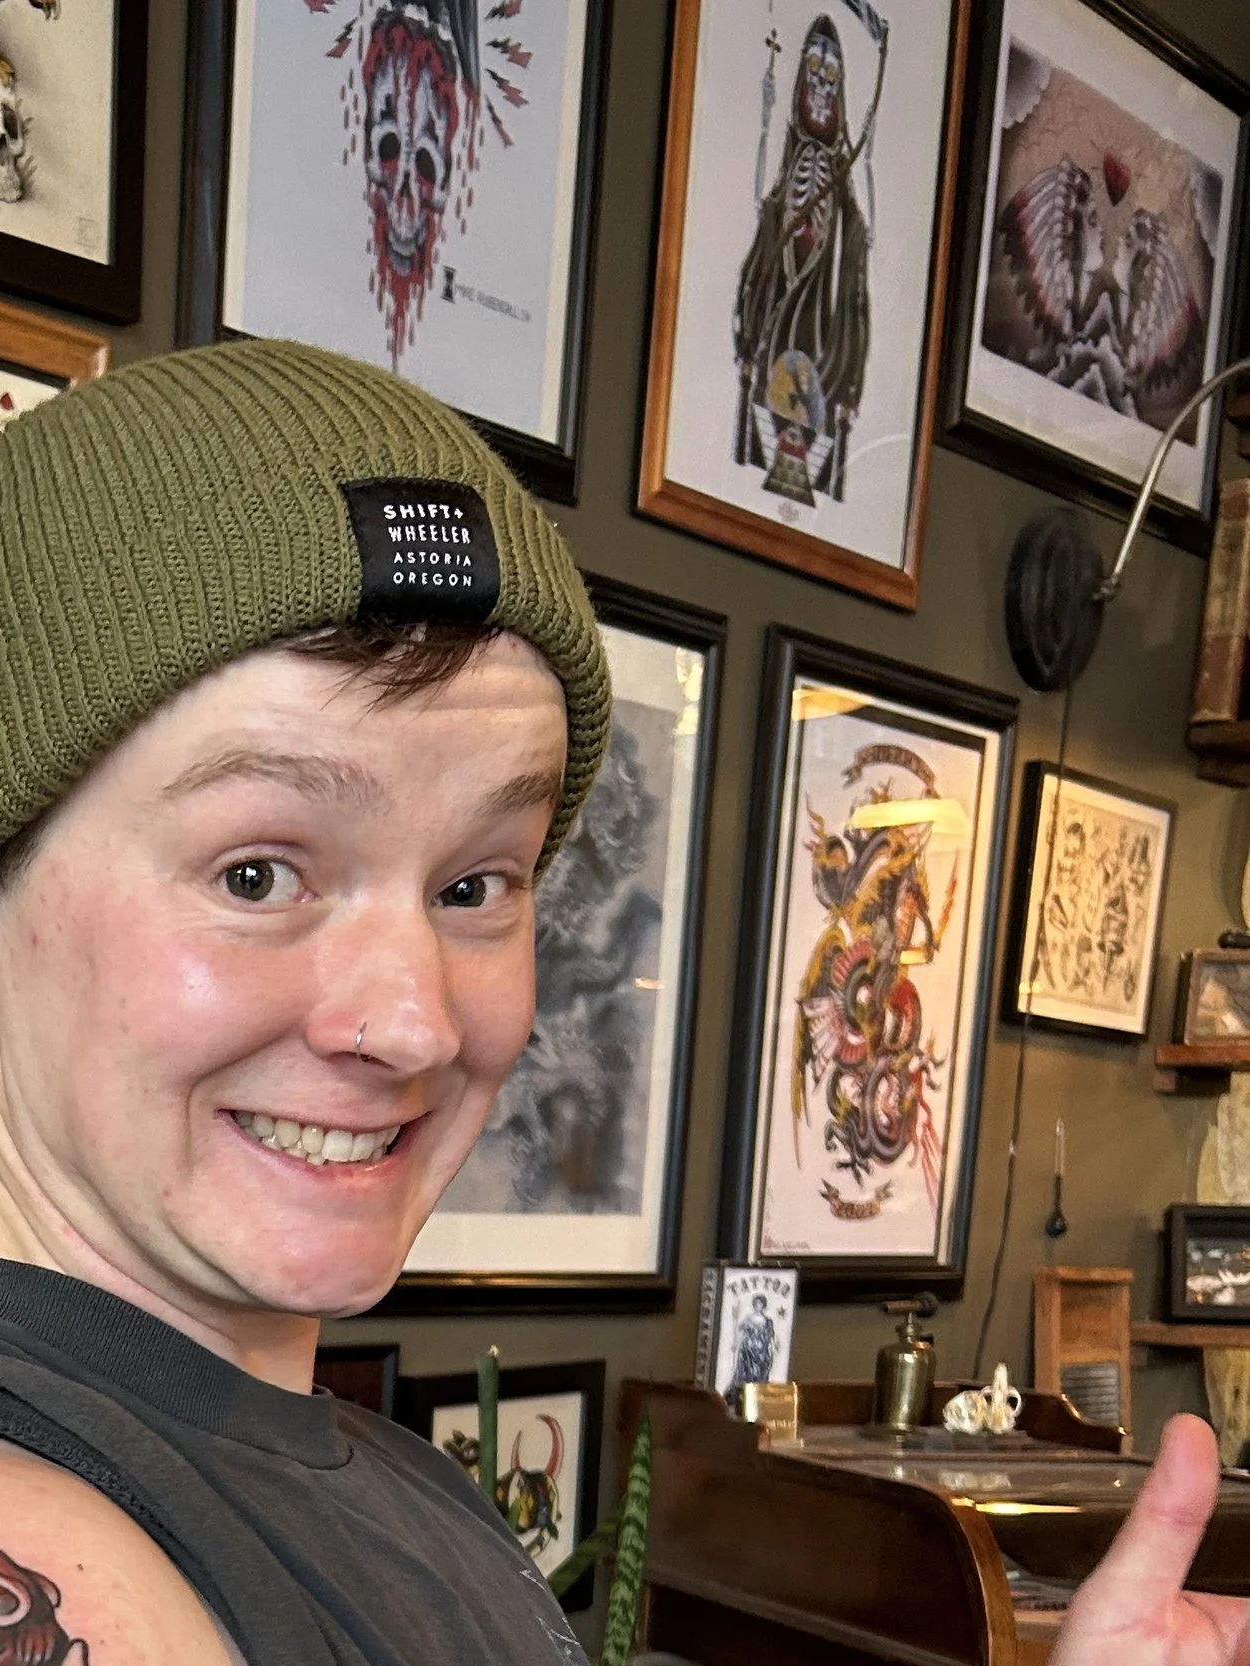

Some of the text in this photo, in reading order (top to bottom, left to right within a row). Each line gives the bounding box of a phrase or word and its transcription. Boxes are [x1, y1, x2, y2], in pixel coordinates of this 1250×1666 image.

[388, 524, 471, 544] WHEELER
[393, 551, 472, 567] ASTORIA
[392, 571, 472, 587] OREGON
[727, 1275, 791, 1299] TATTOO
